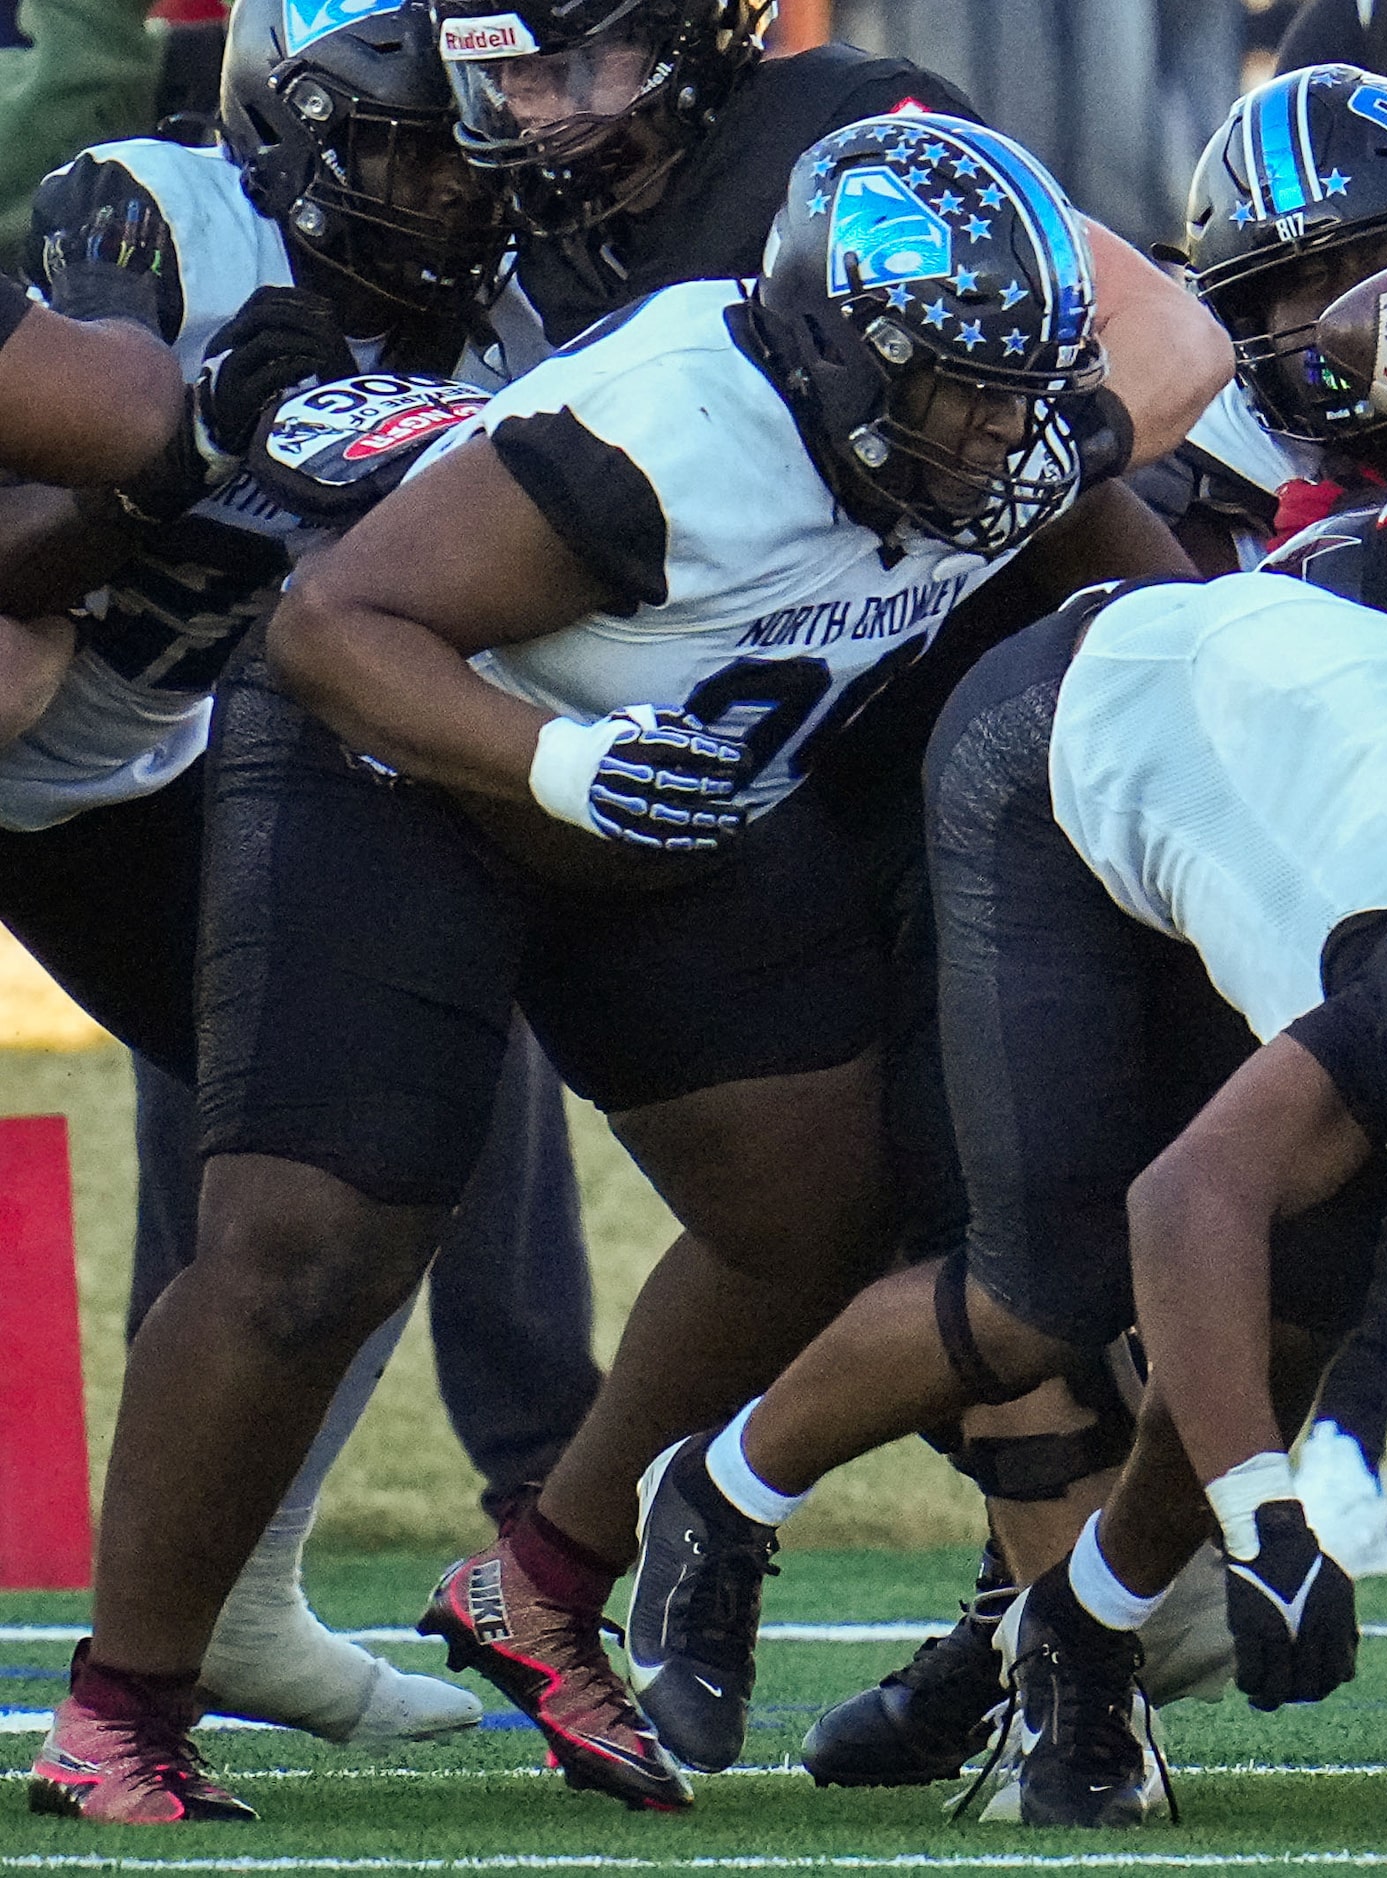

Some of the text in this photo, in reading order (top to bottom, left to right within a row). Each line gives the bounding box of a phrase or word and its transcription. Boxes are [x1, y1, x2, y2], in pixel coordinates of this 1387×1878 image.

[445, 28, 517, 50] Riddell
[1275, 211, 1306, 242] 817
[735, 600, 852, 648] NORTH
[469, 1559, 514, 1645] NIKE
